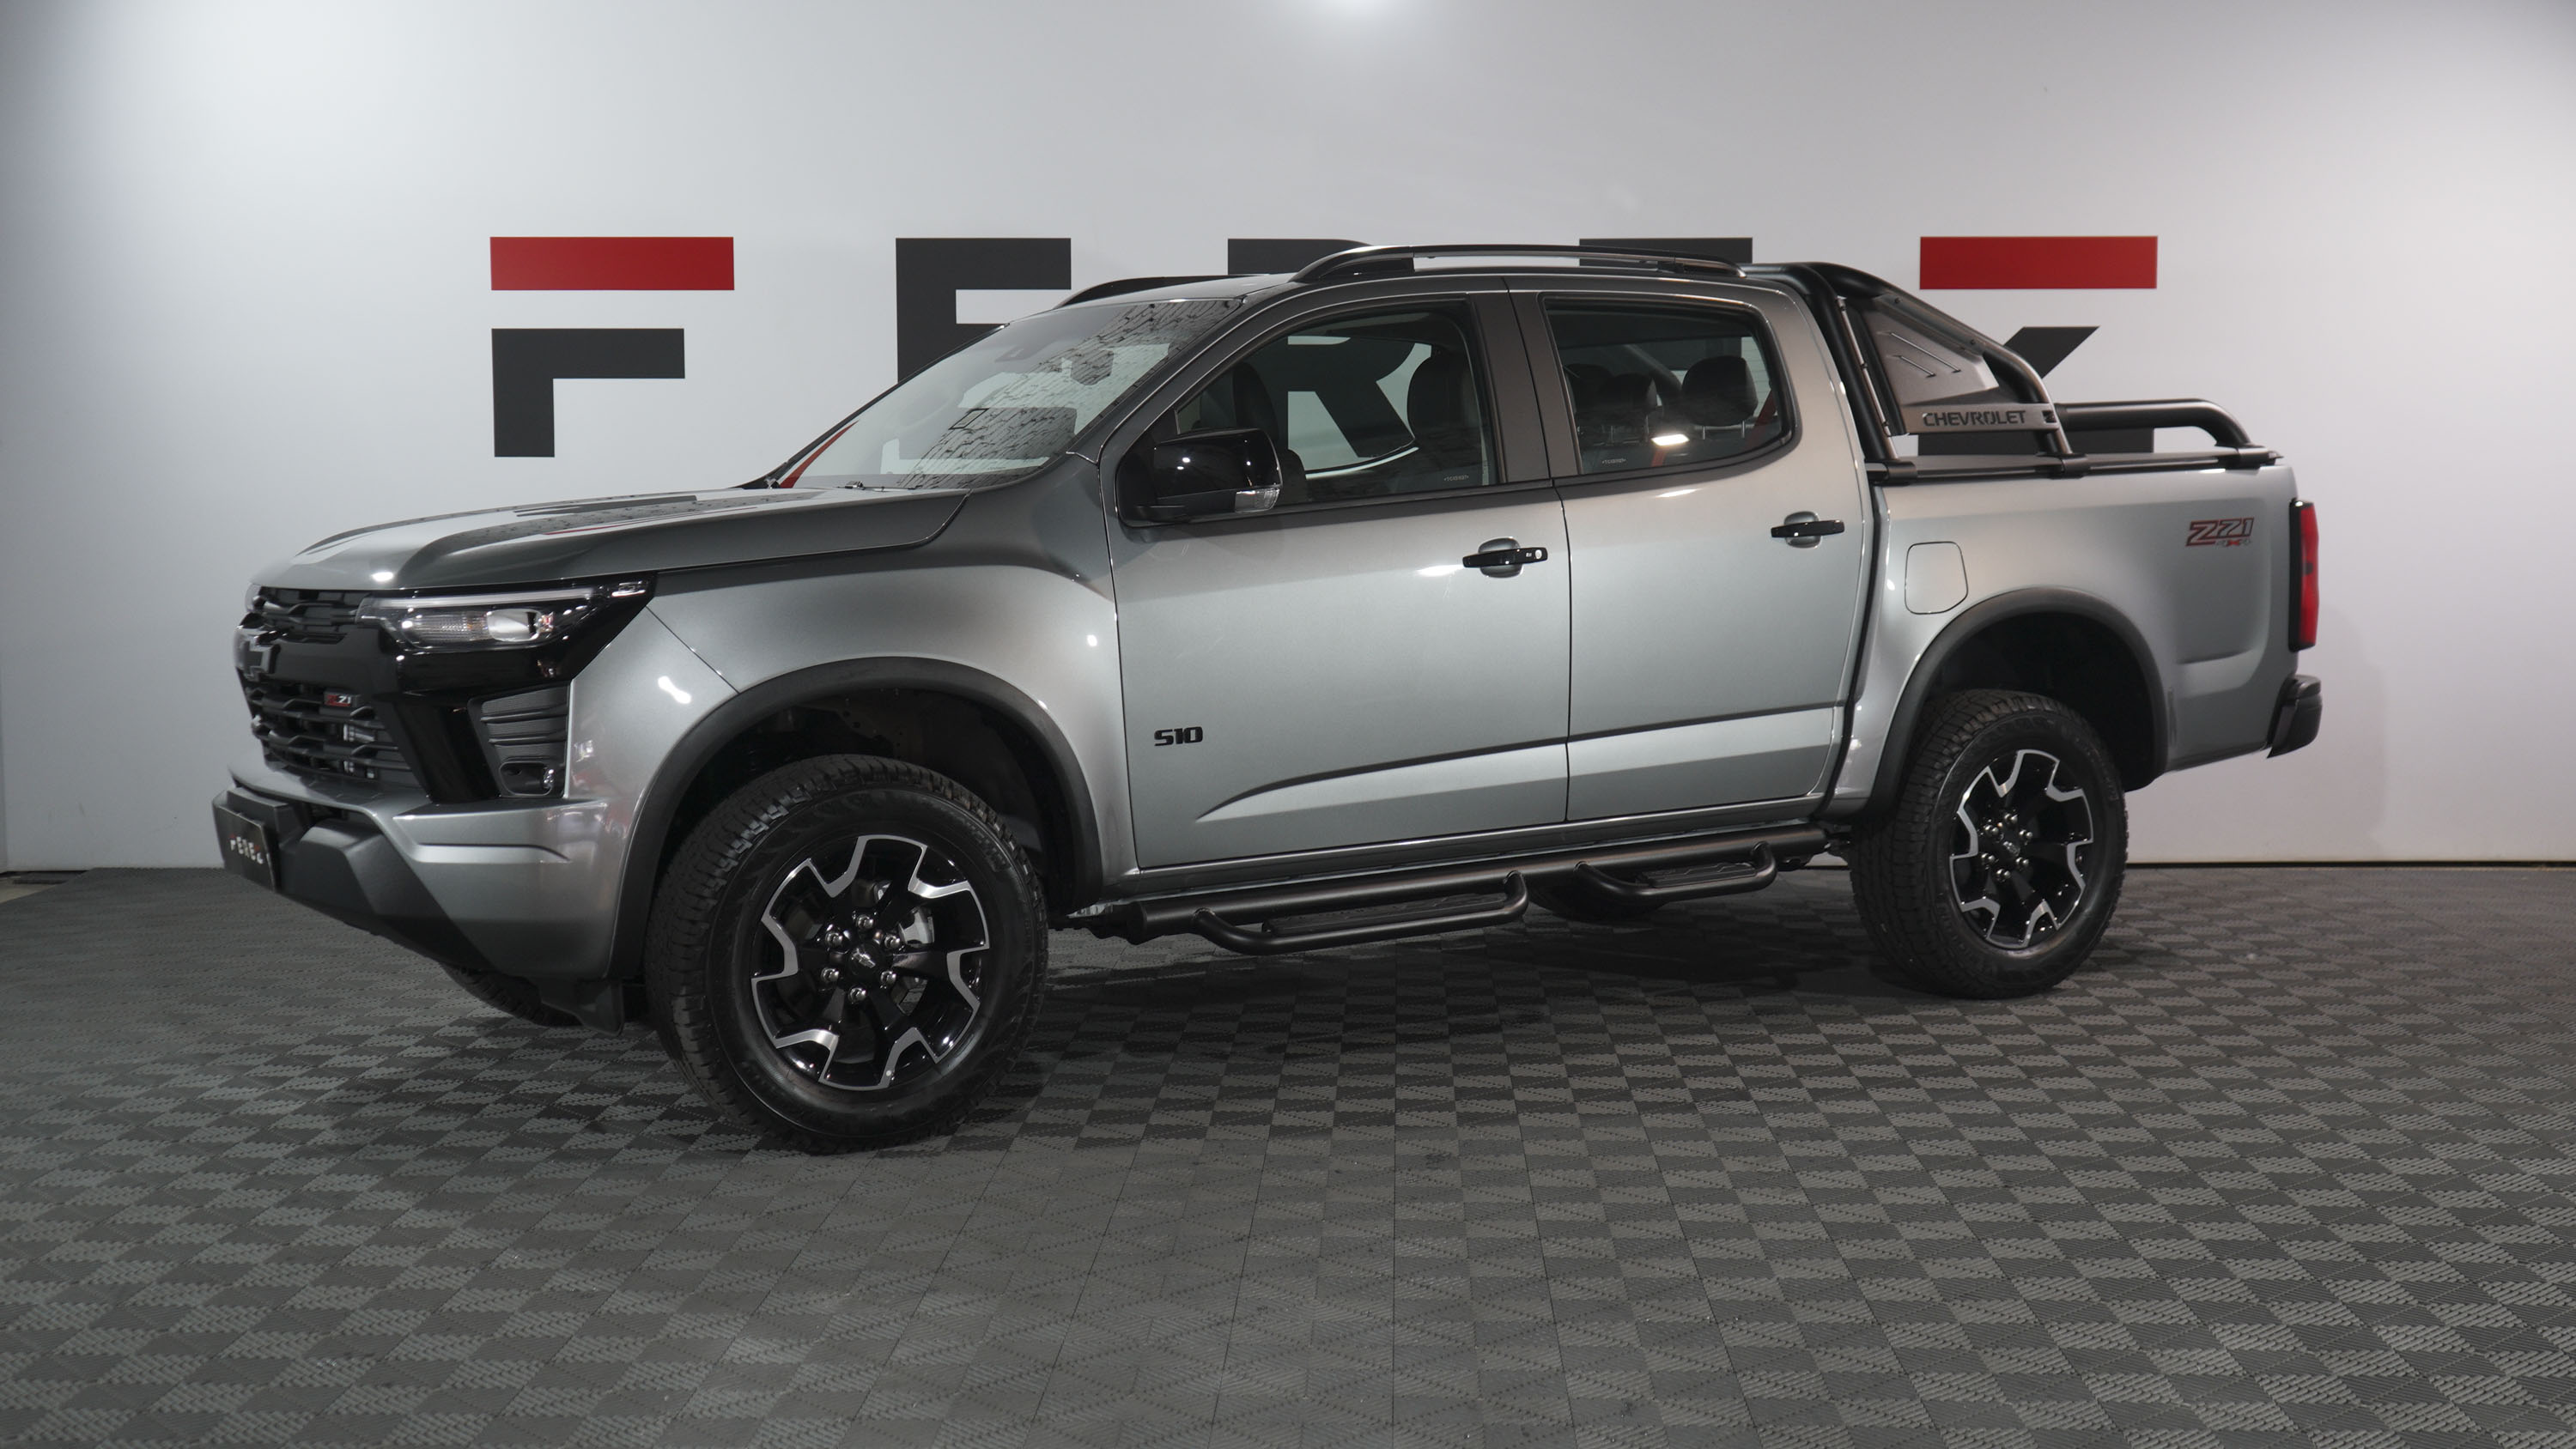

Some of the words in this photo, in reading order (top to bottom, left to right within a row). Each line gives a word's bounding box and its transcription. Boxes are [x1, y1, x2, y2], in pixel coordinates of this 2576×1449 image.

[1923, 410, 2026, 427] CHEVROLET
[2185, 517, 2255, 547] Z71
[1154, 726, 1203, 746] S10
